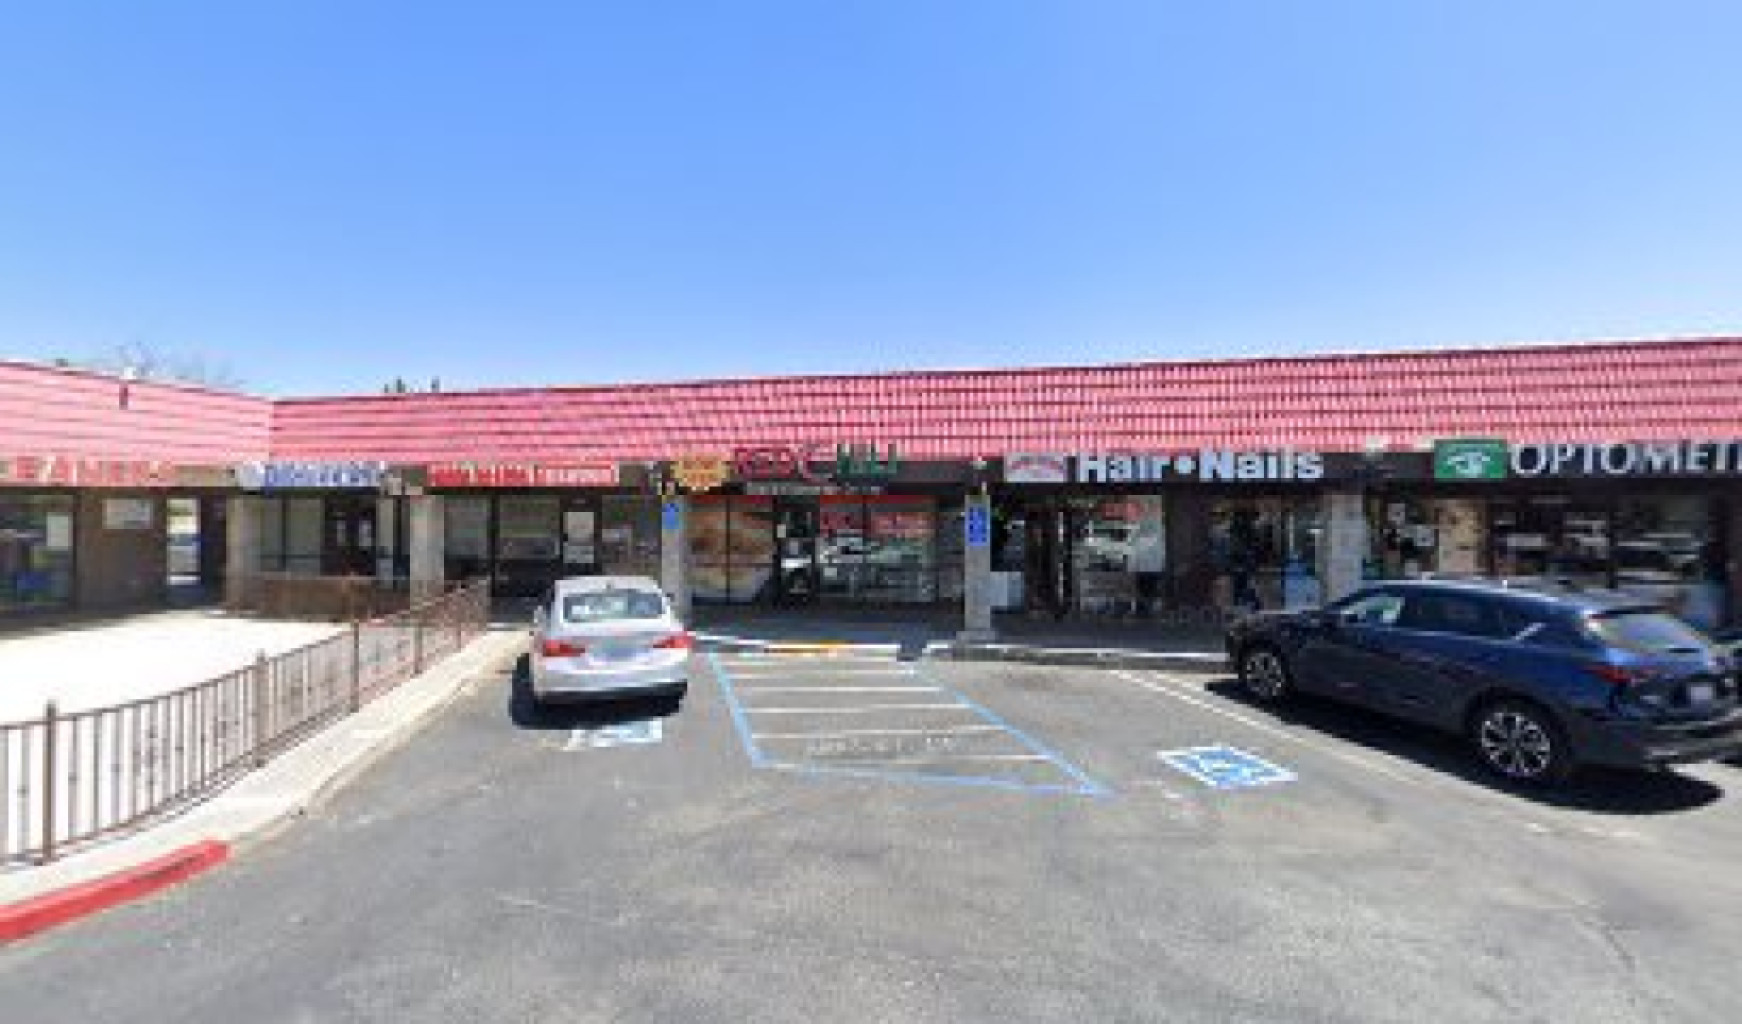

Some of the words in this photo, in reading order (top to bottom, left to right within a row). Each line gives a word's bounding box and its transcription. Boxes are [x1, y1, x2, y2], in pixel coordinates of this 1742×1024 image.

[1077, 450, 1172, 482] Hair
[1199, 446, 1325, 480] Nails
[1511, 441, 1742, 475] OPTOMET
